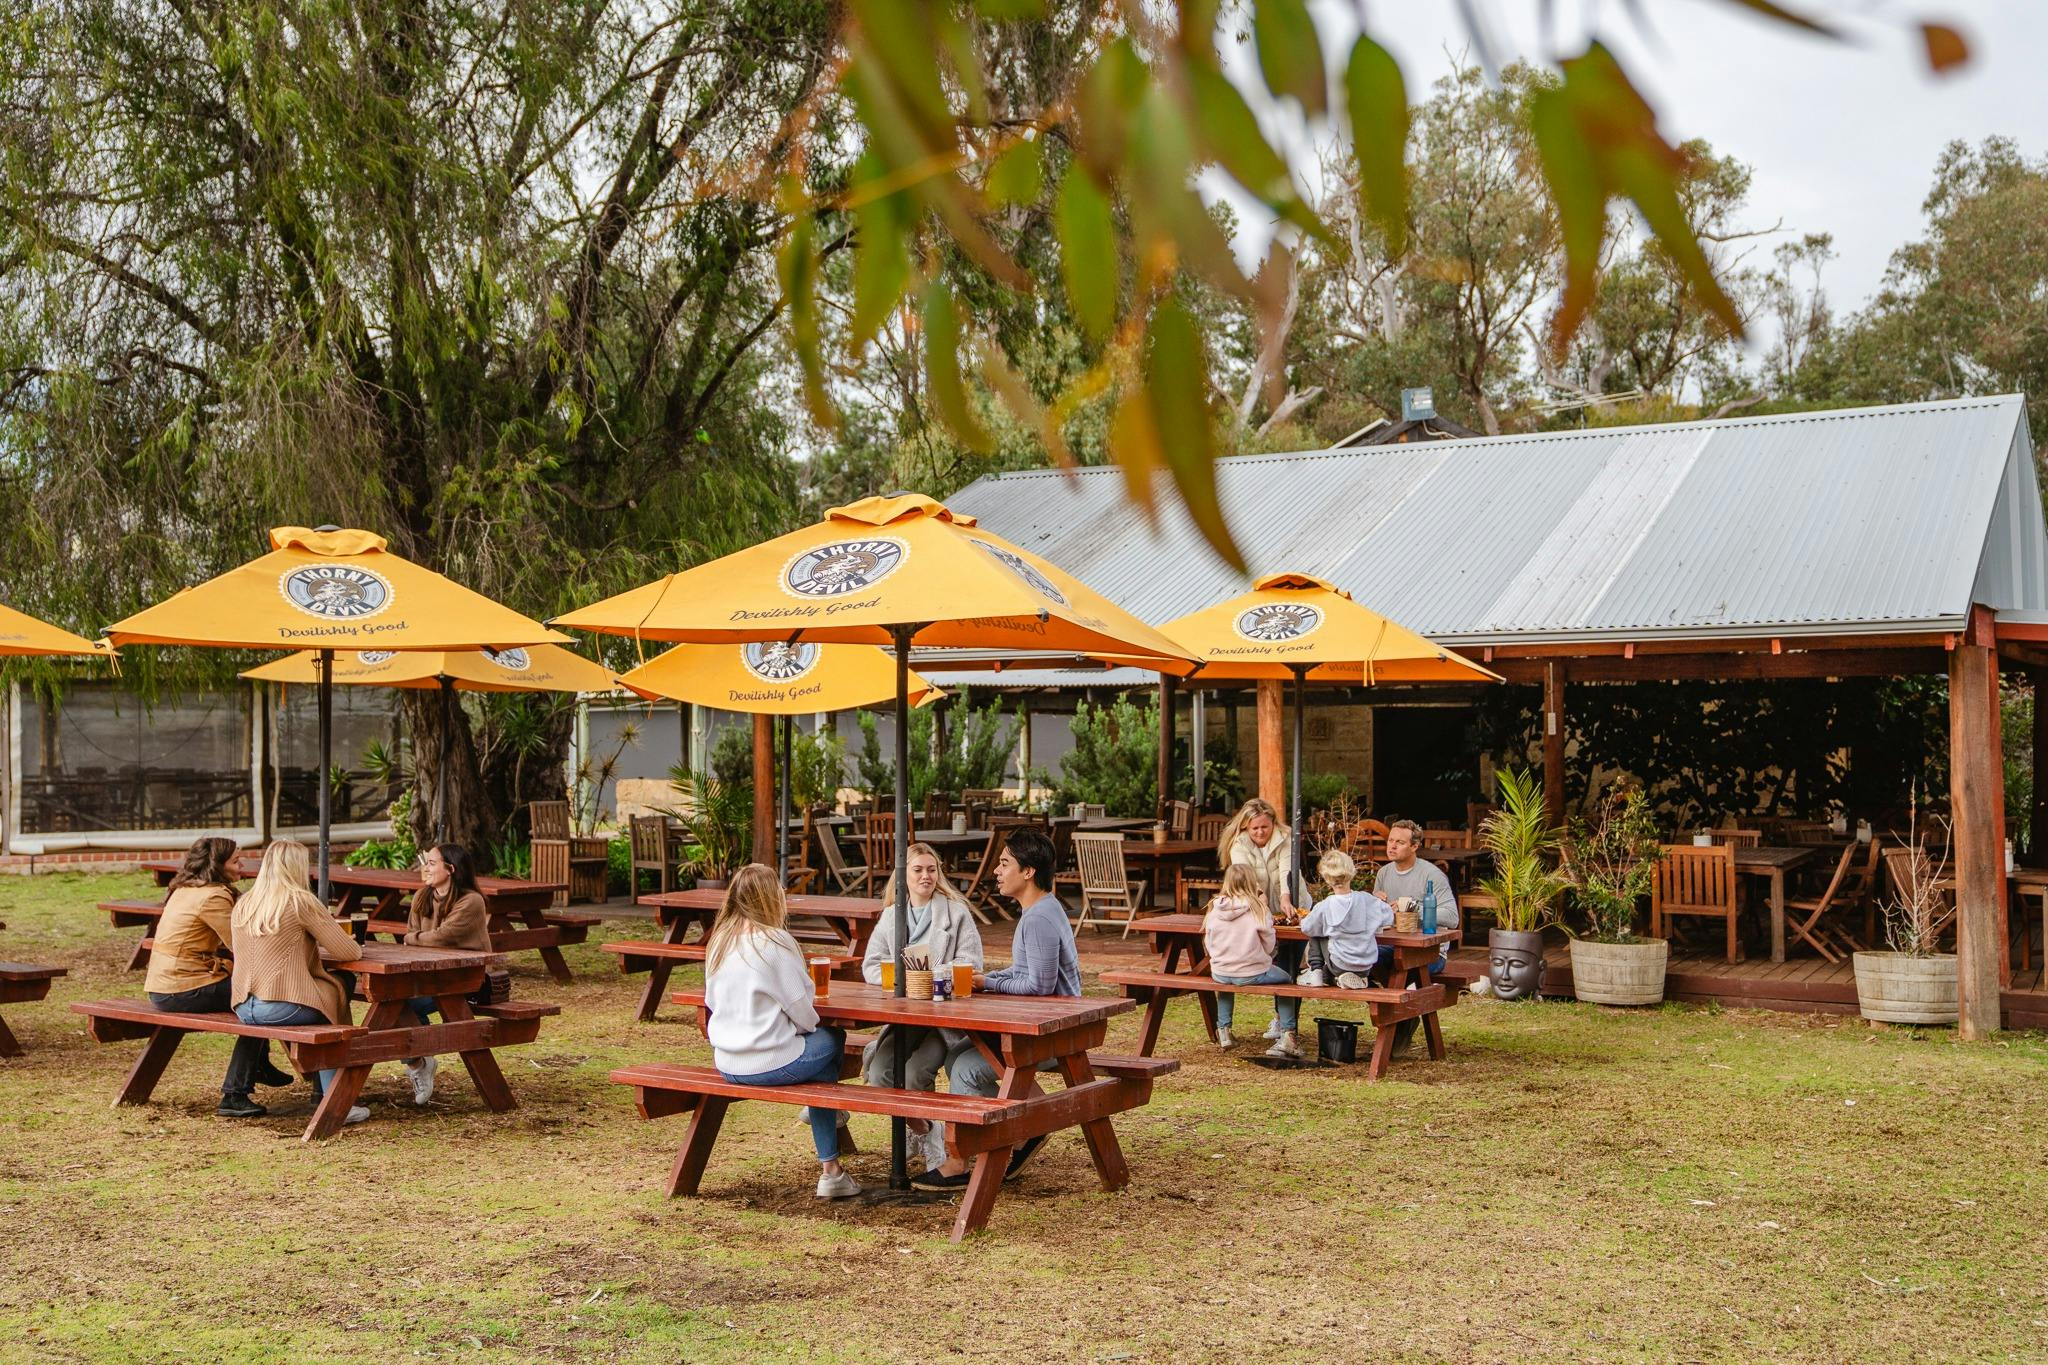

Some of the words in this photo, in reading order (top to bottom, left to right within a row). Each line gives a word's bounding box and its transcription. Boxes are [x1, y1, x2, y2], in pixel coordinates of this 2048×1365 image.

[813, 542, 898, 559] THORNY
[294, 568, 375, 585] THORNY
[796, 580, 863, 594] DEVIL
[310, 602, 372, 616] DEVIL
[729, 606, 821, 622] Devilishly
[826, 597, 882, 616] Good
[1253, 605, 1316, 617] THORNY
[278, 625, 359, 639] Devilishly
[362, 621, 410, 635] Good
[1250, 629, 1297, 640] DEVIL
[1209, 647, 1273, 656] Devilishly
[1276, 644, 1315, 654] Good
[757, 664, 802, 678] DEVIL
[729, 688, 785, 702] Devilishly
[788, 683, 822, 700] Good
